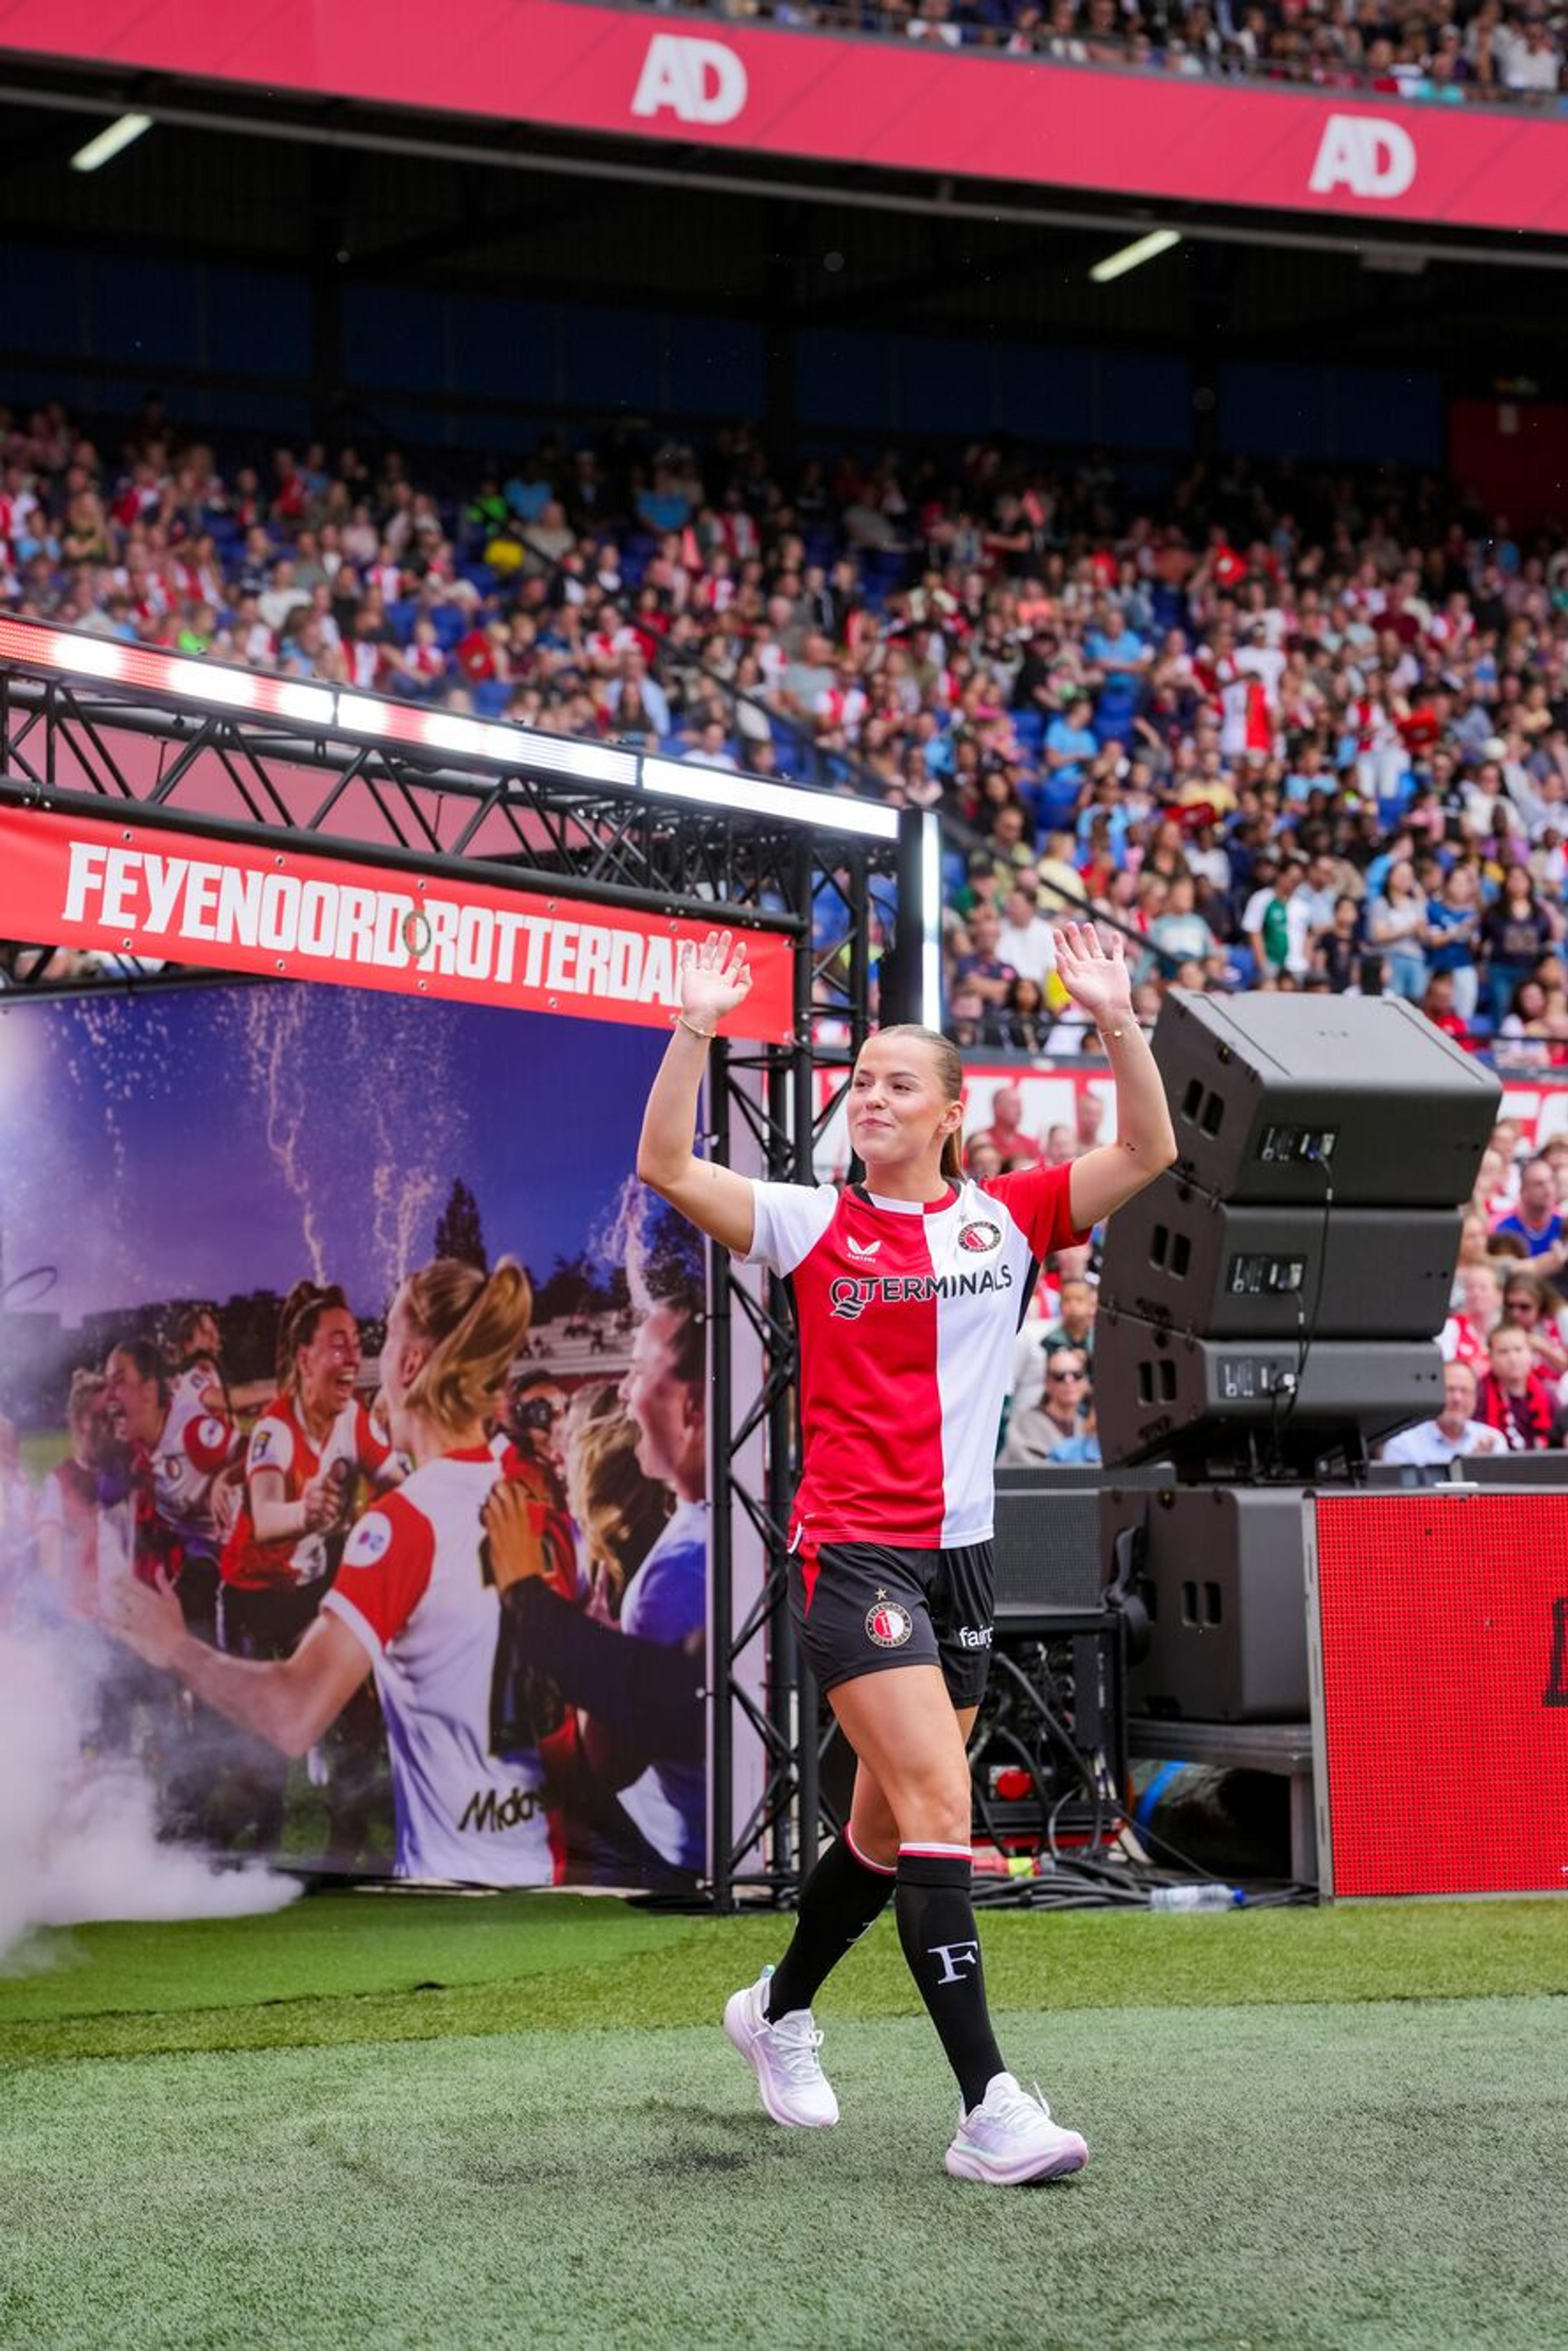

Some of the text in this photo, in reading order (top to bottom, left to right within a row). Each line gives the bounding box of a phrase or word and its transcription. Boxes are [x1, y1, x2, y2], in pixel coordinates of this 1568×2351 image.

[630, 33, 748, 126] AD
[1308, 113, 1417, 199] AD
[62, 841, 718, 1007] FEYENOORD ROTTERDA
[831, 1265, 1012, 1320] QTERMINALS
[927, 1940, 978, 1985] F
